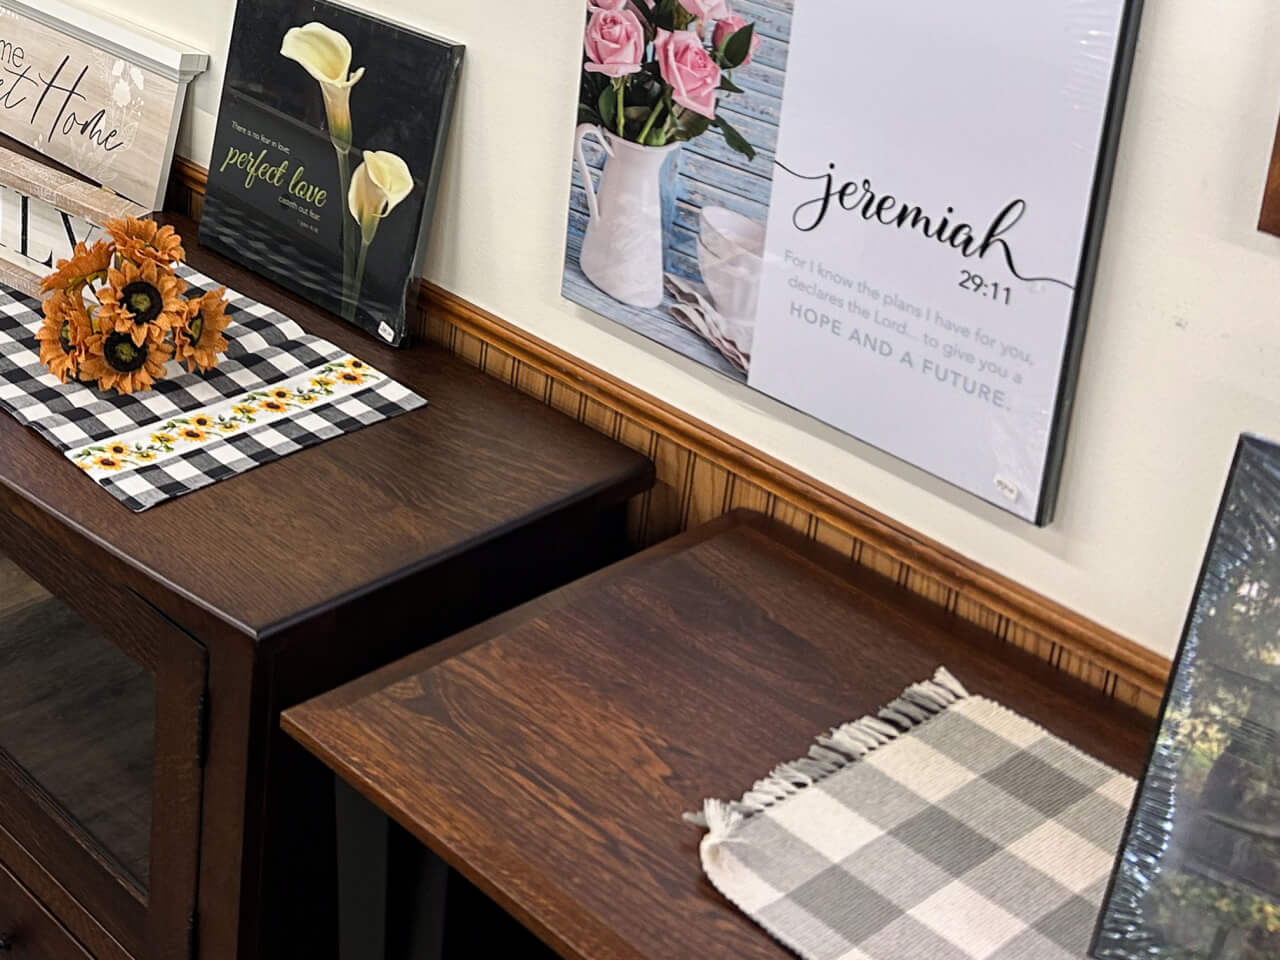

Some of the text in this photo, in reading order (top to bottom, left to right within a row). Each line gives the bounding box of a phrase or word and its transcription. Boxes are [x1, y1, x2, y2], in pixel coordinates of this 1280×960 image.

[31, 55, 124, 152] Home
[220, 146, 328, 208] perfect love
[775, 162, 1070, 290] jeremiah
[783, 248, 807, 269] For
[809, 259, 816, 273] I
[817, 260, 855, 289] know
[857, 280, 881, 301] the
[882, 291, 922, 320] plans
[924, 306, 932, 321] I
[933, 311, 971, 339] have
[975, 327, 997, 347] for
[787, 274, 845, 309] declares
[847, 299, 871, 320] the
[923, 331, 940, 350] to
[942, 342, 976, 367] give
[977, 358, 1009, 382] you
[1012, 371, 1023, 385] a
[958, 269, 1013, 306] 29:11
[789, 301, 1012, 412] HOPE AND A FUTURE.
